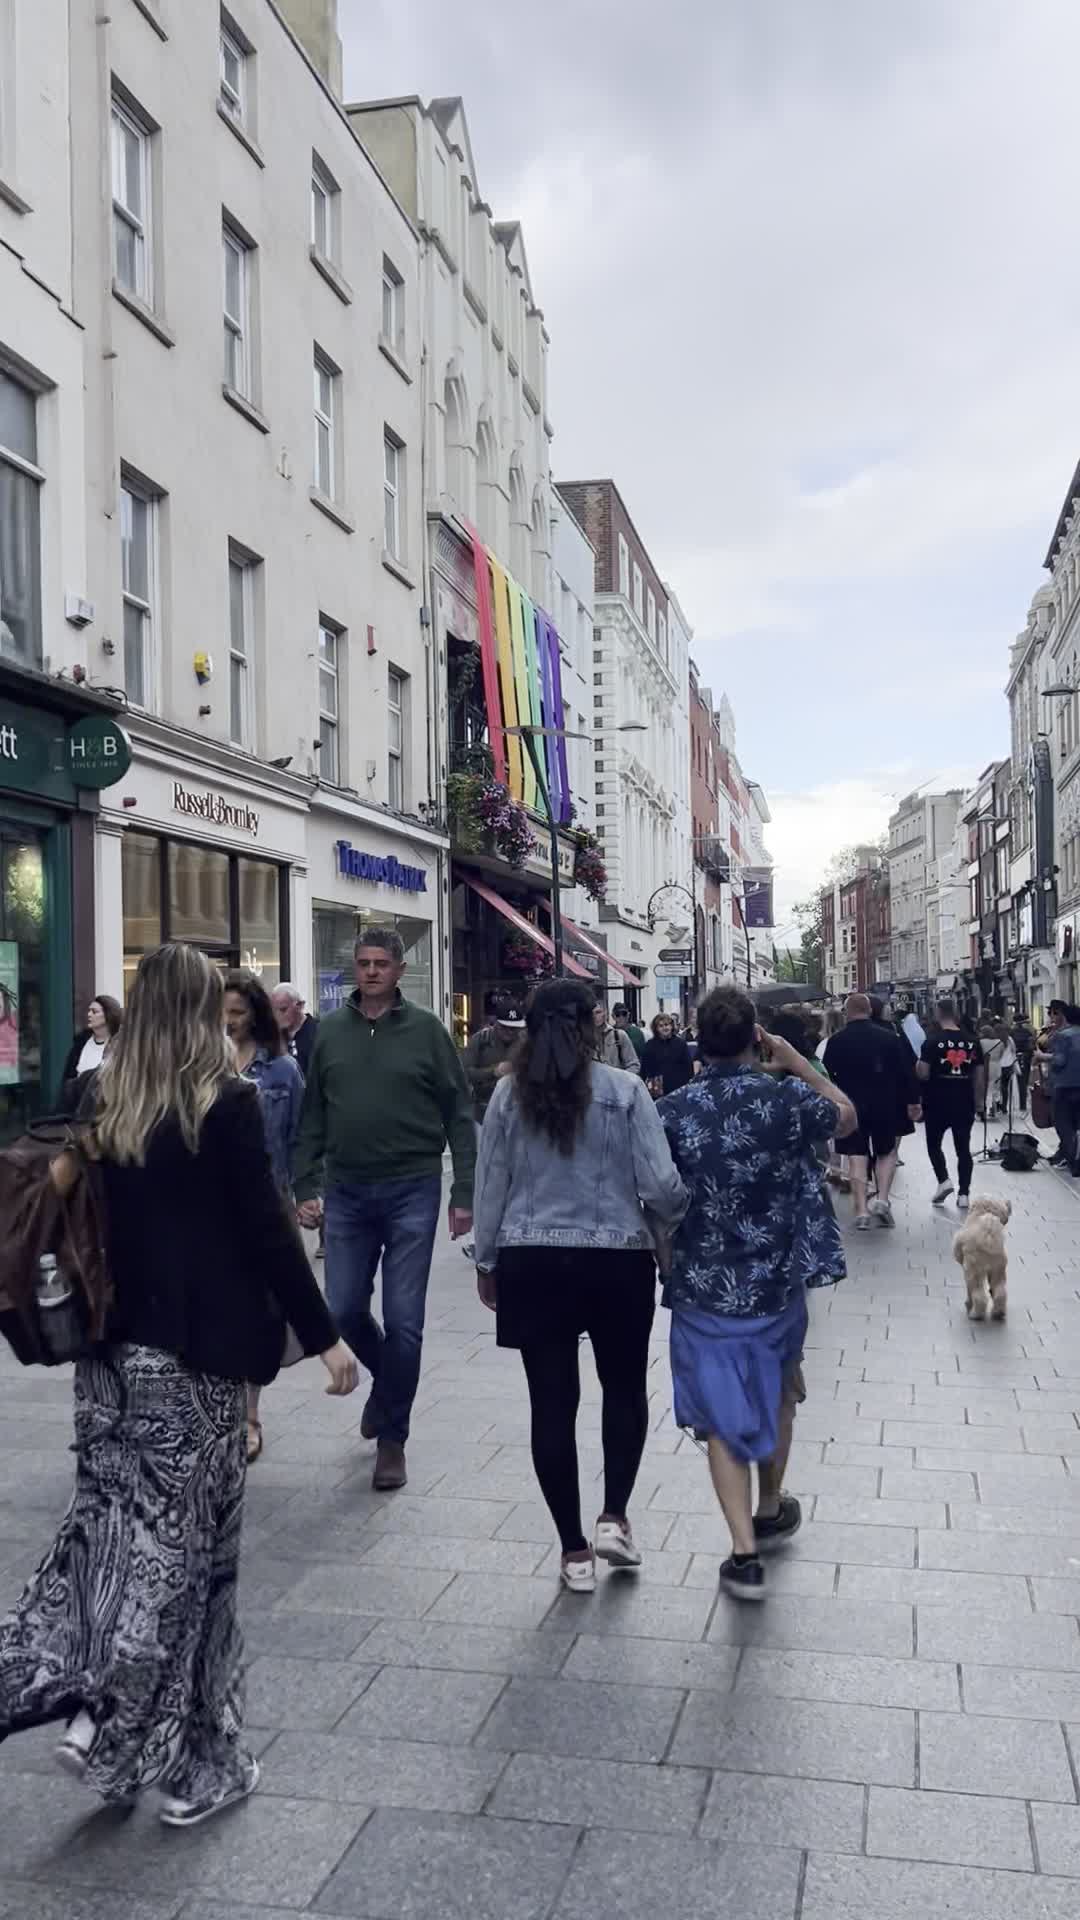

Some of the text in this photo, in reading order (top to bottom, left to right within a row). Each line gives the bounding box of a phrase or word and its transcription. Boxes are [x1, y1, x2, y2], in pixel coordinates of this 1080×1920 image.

[0, 724, 18, 760] tt
[336, 840, 388, 884] THOMAS
[937, 1040, 974, 1050] obey
